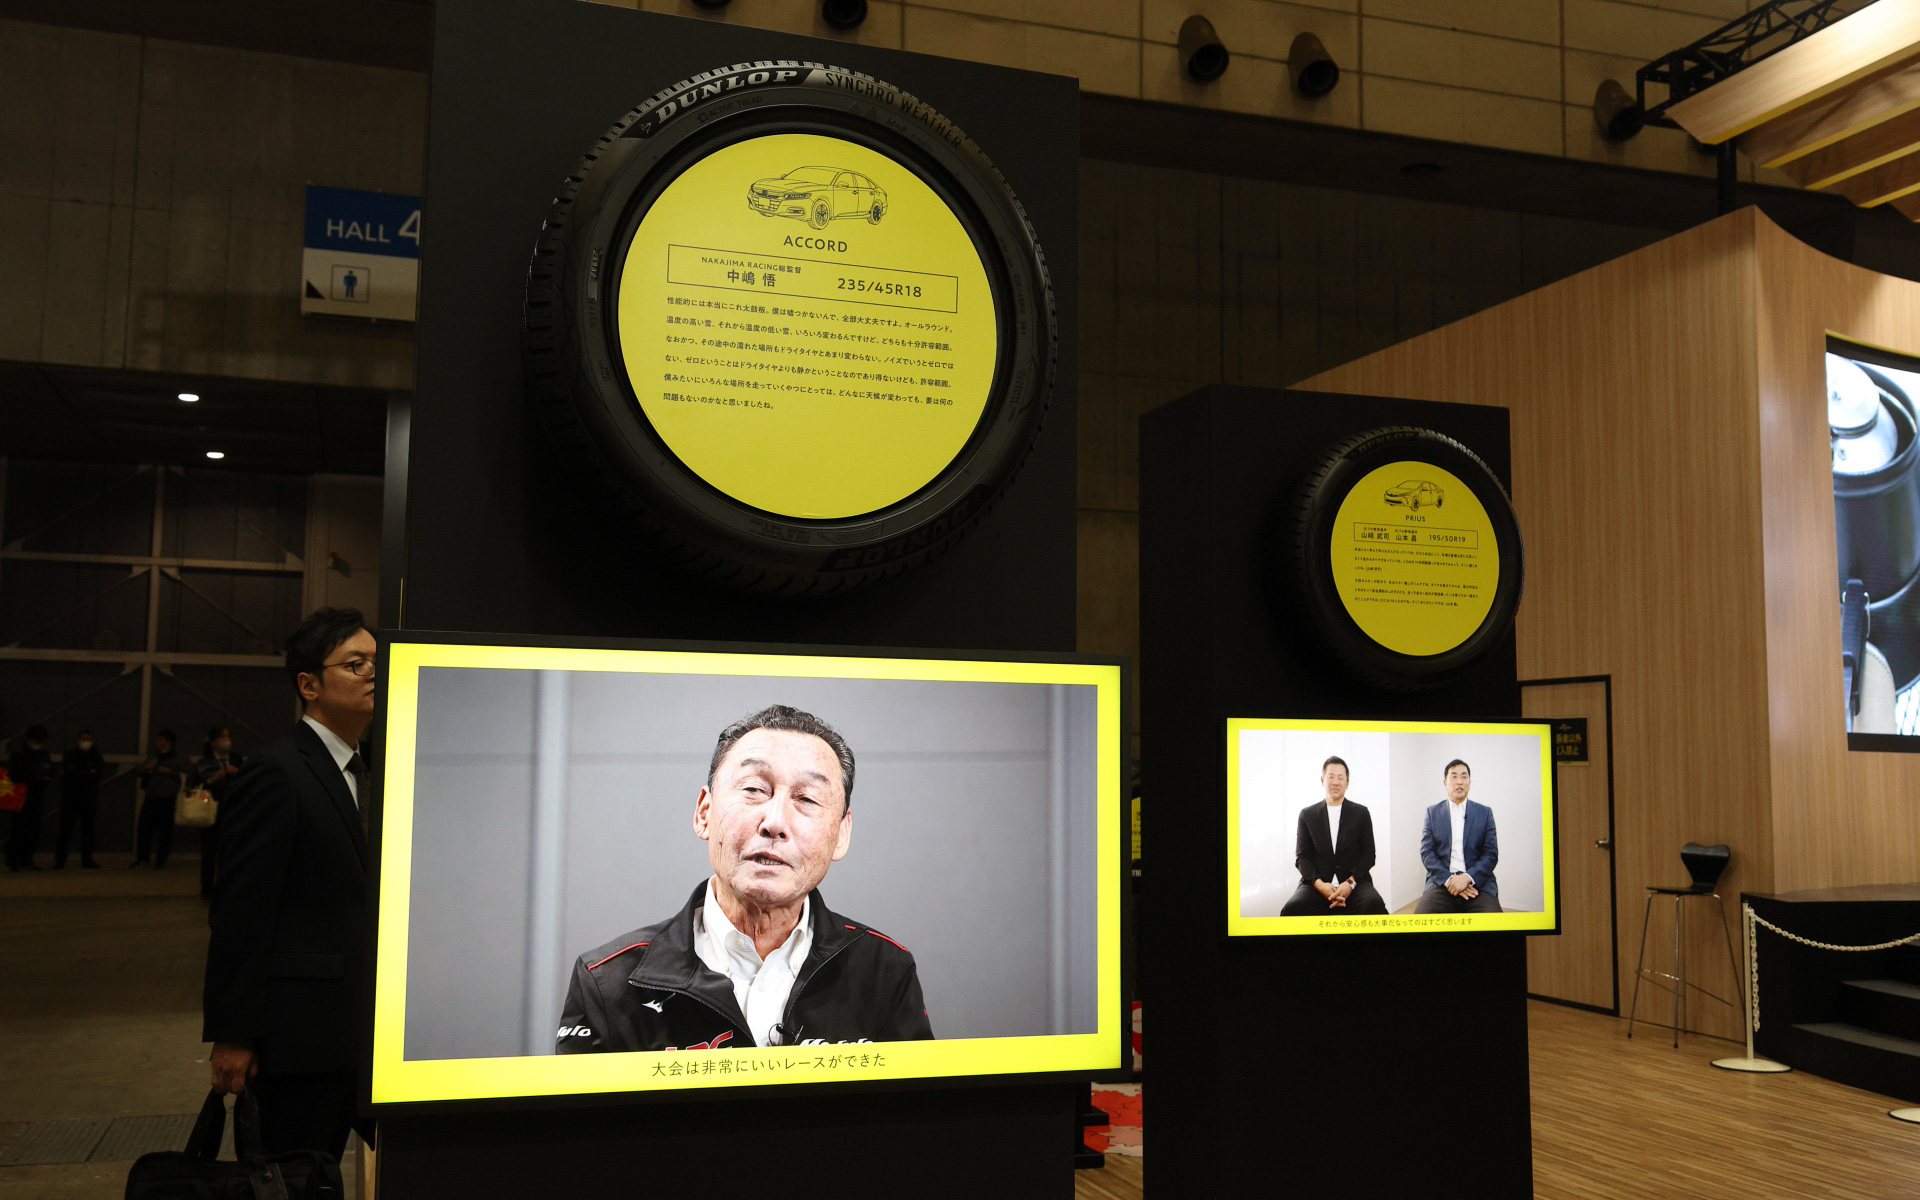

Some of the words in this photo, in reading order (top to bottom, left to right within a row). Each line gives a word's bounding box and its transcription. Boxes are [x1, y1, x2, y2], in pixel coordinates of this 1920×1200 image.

[656, 70, 798, 123] DUNLOP
[825, 72, 895, 106] SYNCHRO
[900, 97, 962, 148] WEATHER
[327, 218, 390, 243] HALL
[398, 210, 420, 246] 4
[783, 235, 848, 253] ACCORD
[701, 256, 745, 268] NAKAJIMA
[747, 262, 802, 275] RACING総監督
[726, 269, 756, 286] 中嶋
[762, 272, 777, 287] 悟
[837, 277, 922, 298] 235/45R18
[663, 392, 774, 410] 問題もないのかなと思いましたね。
[1405, 514, 1426, 523] PRIUS
[1396, 533, 1409, 542] 山本
[1429, 534, 1466, 543] 195/50R19
[1318, 917, 1473, 928] それから安心感も大事だなってのはすごく思います
[651, 1052, 887, 1078] 大会は非常にいいレースができた
